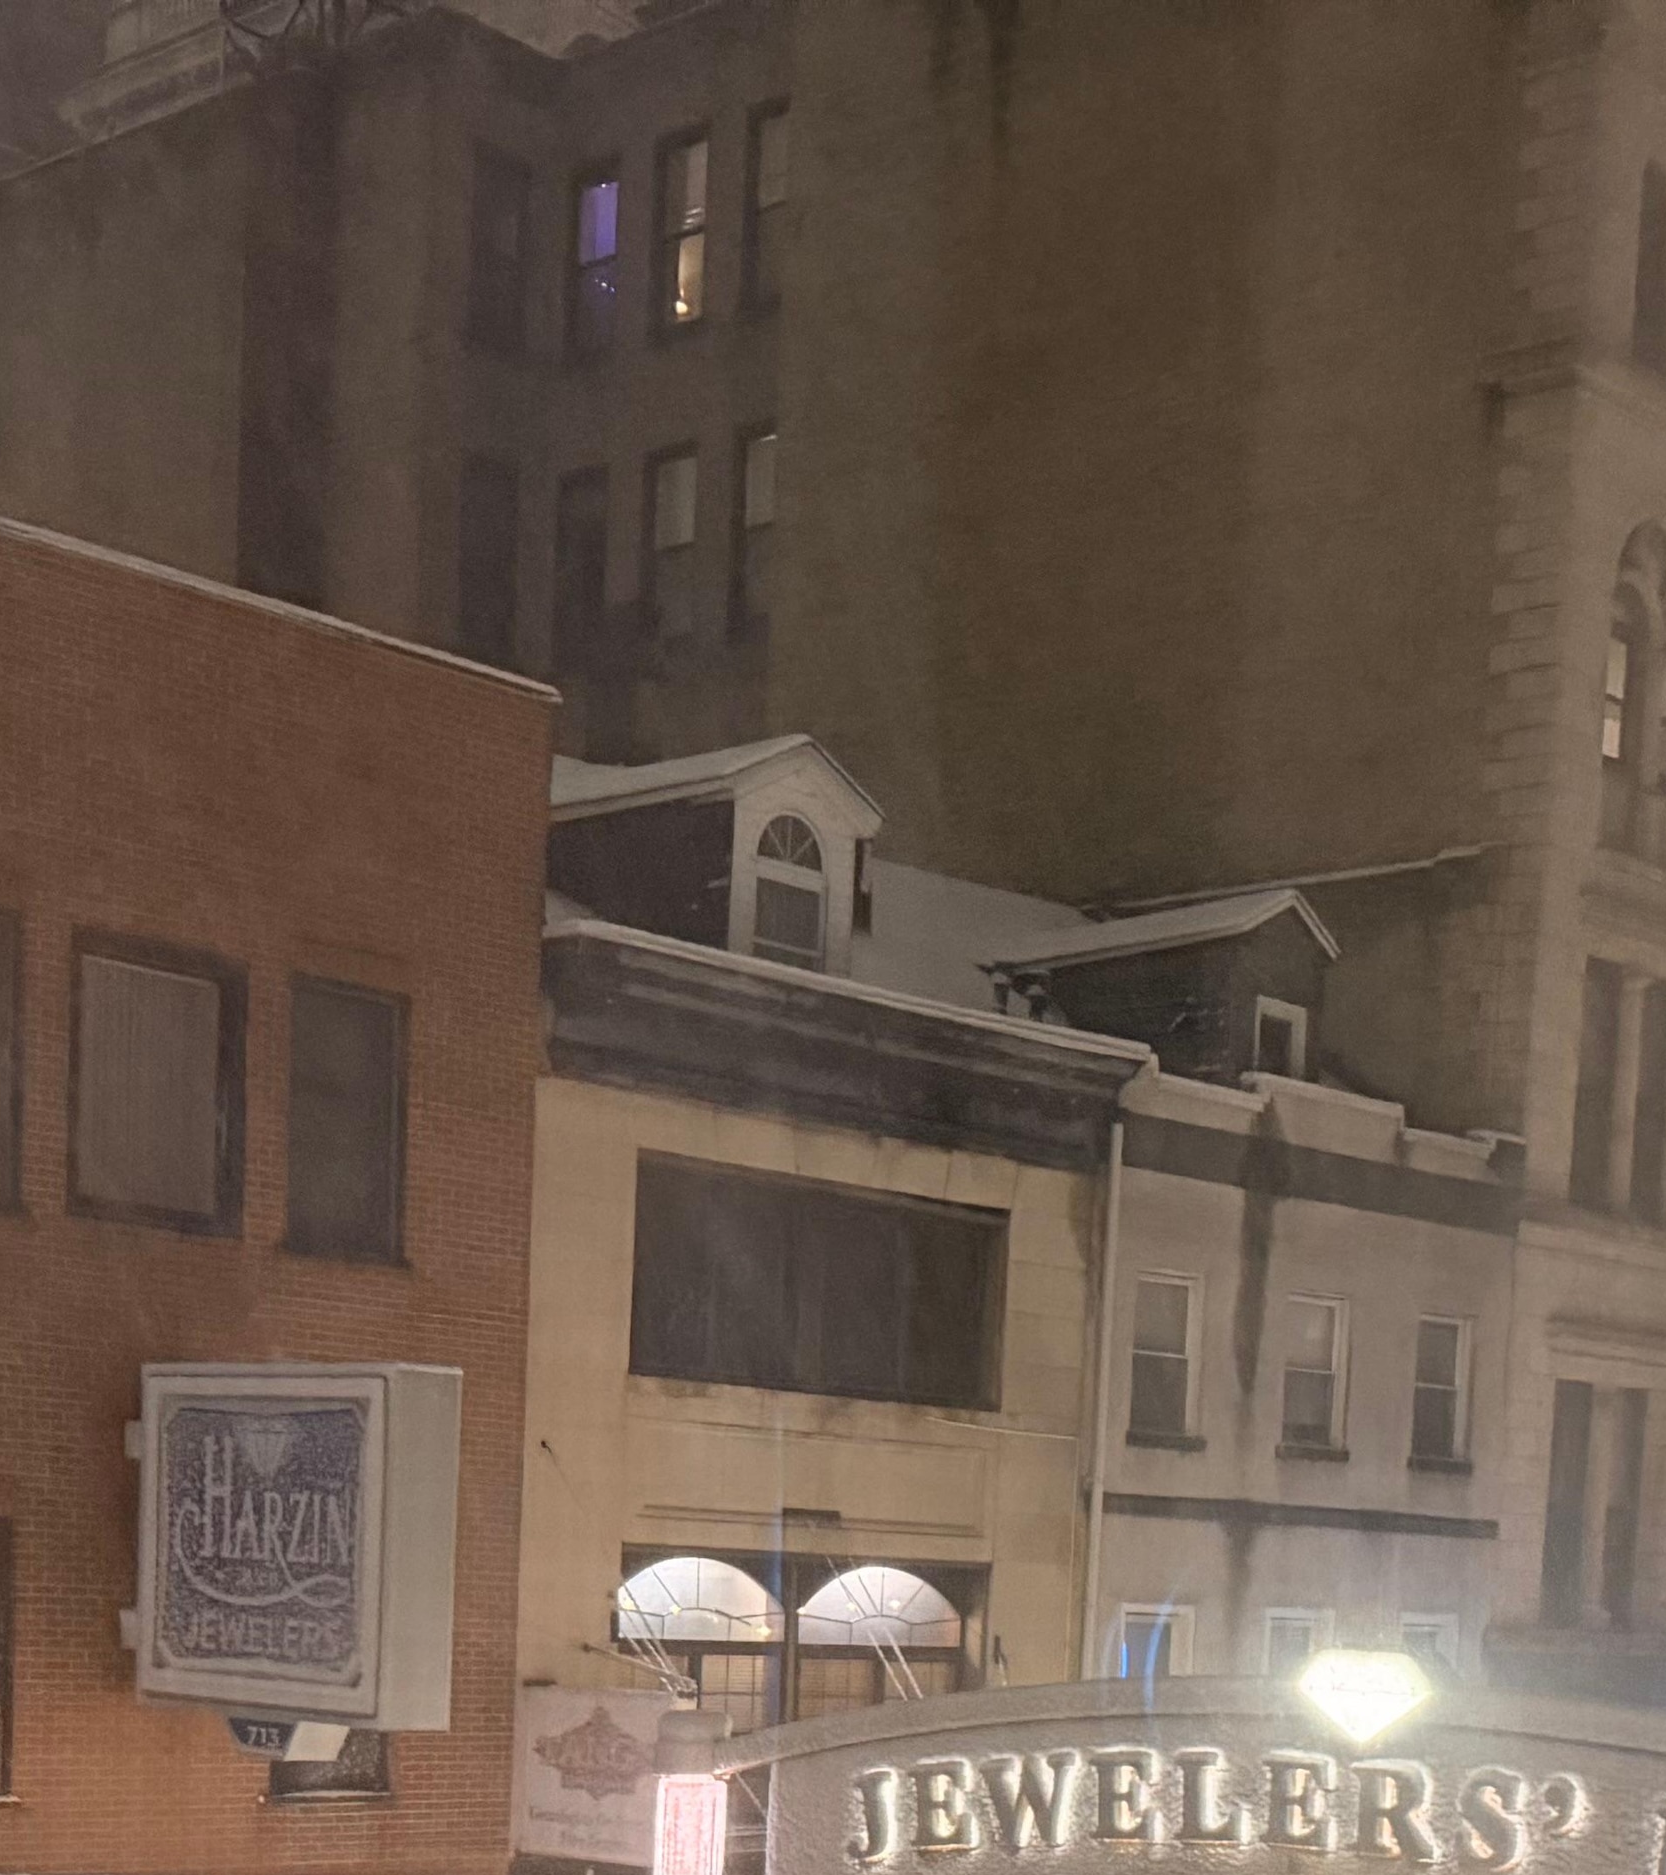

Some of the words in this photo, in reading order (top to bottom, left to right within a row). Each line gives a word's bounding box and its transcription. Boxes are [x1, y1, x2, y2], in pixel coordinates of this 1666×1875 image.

[178, 1434, 352, 1598] HARZIN
[247, 1725, 280, 1746] 713
[849, 1745, 1589, 1870] JEWELERS'
